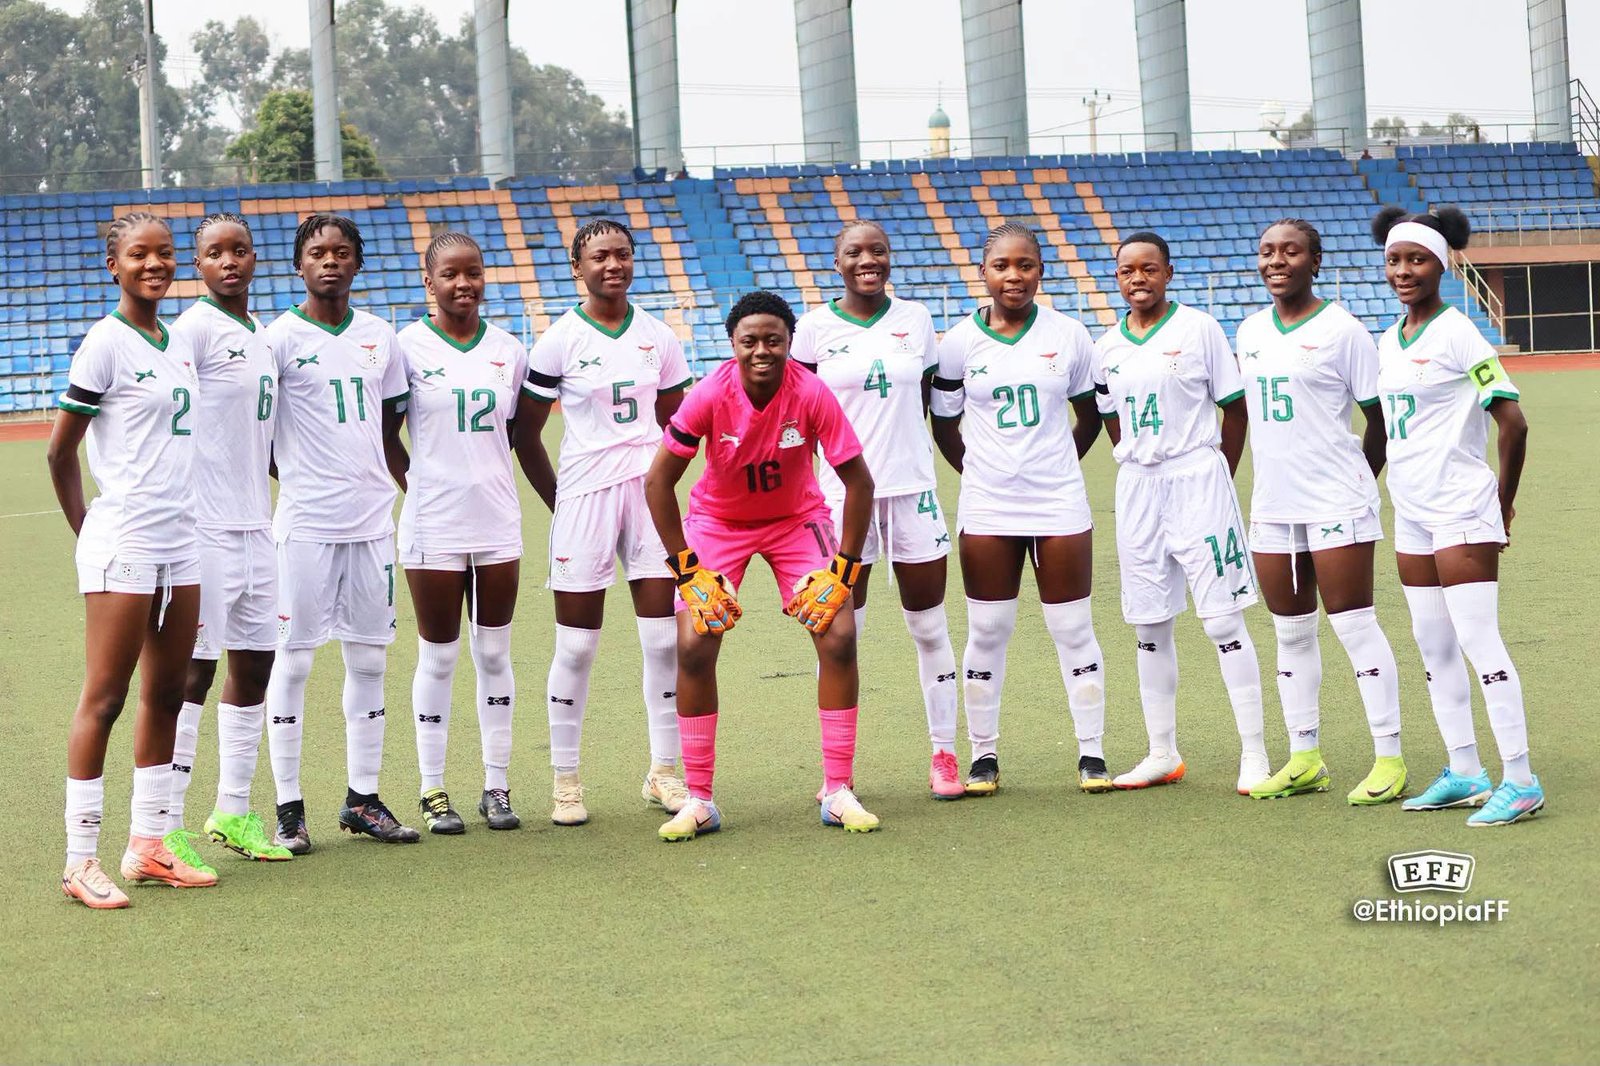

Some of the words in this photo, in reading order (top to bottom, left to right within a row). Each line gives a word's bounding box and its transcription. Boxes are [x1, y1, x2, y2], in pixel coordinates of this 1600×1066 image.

[863, 359, 893, 399] 4
[1474, 363, 1496, 387] C
[171, 387, 191, 436] 2
[257, 375, 273, 421] 6
[330, 376, 366, 423] 11
[452, 388, 496, 432] 12
[612, 380, 638, 424] 5
[992, 384, 1040, 428] 20
[1125, 393, 1164, 438] 14
[1256, 376, 1295, 422] 15
[1387, 394, 1416, 440] 17
[743, 460, 783, 494] 16
[917, 490, 938, 520] 4
[1204, 527, 1244, 578] 14
